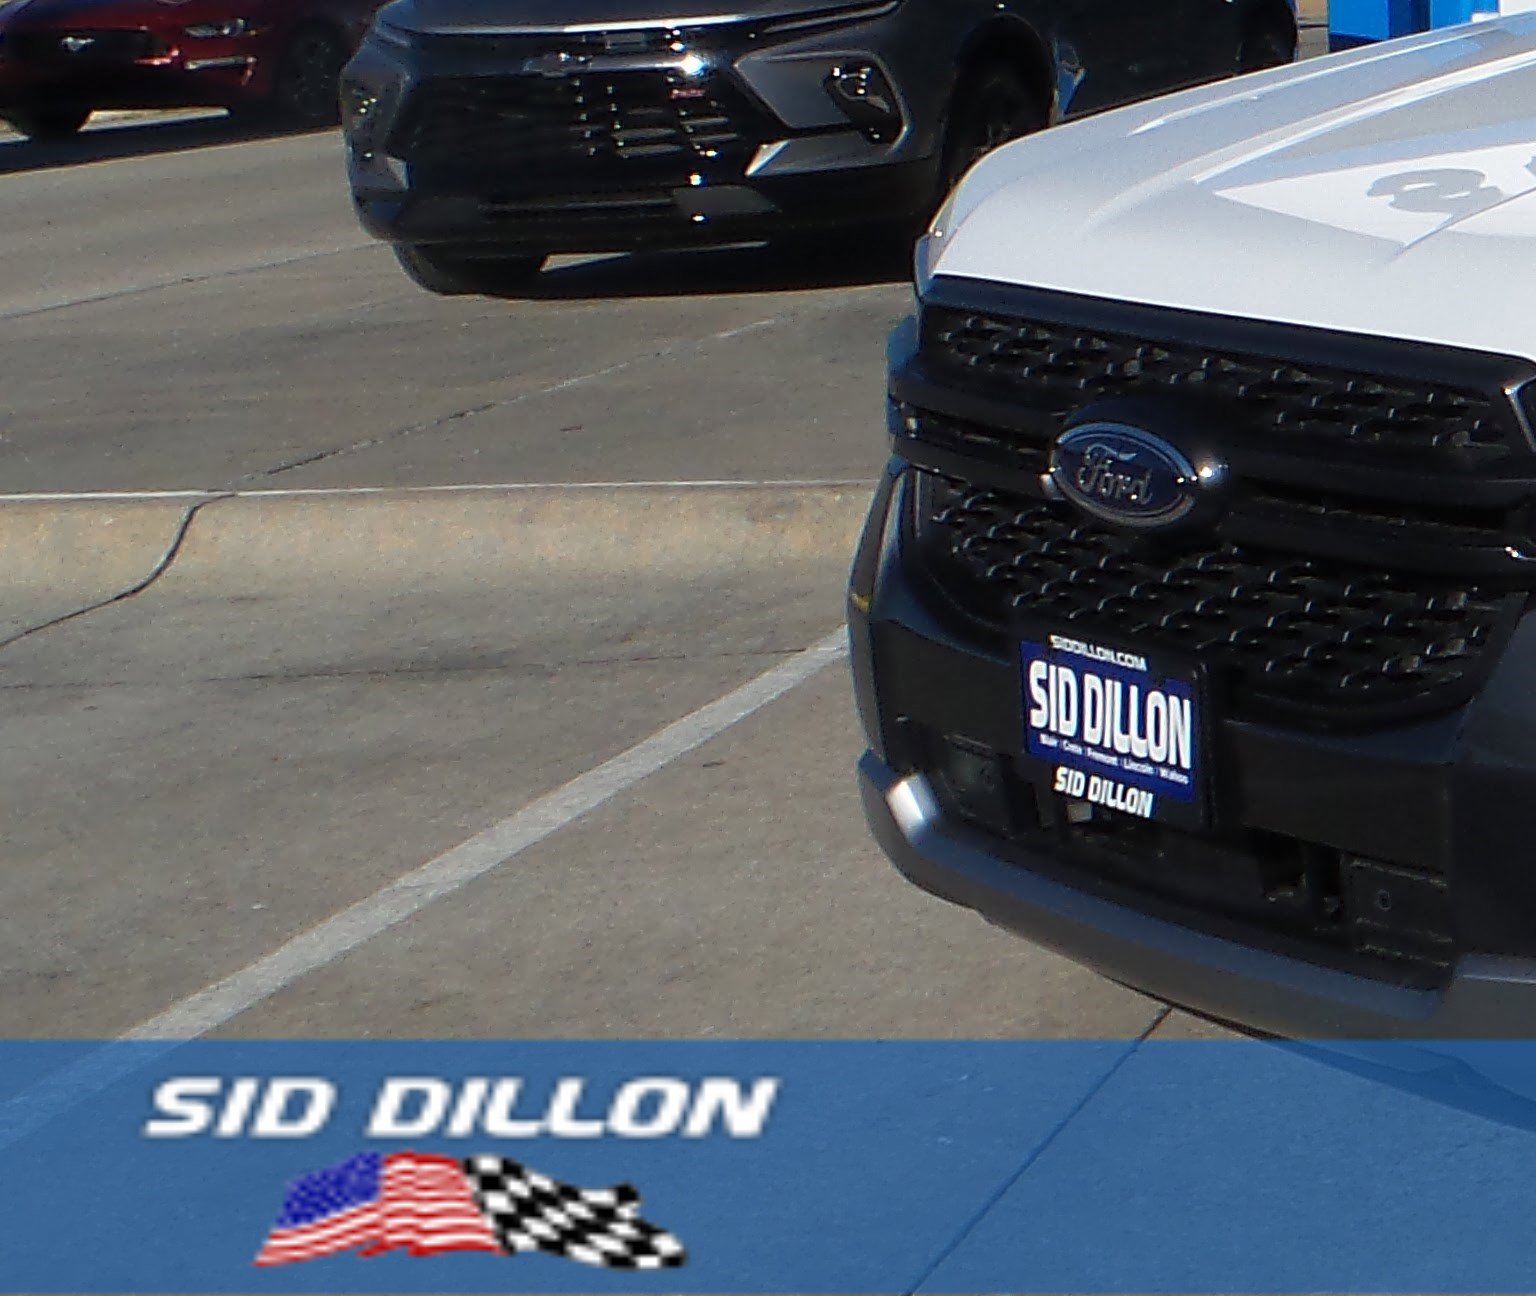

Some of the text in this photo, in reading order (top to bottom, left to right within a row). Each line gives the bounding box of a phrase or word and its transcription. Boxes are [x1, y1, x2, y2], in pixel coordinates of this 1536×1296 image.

[1078, 443, 1153, 505] Ford
[1029, 660, 1192, 770] SID DILLON
[1053, 765, 1154, 819] SID DILLON
